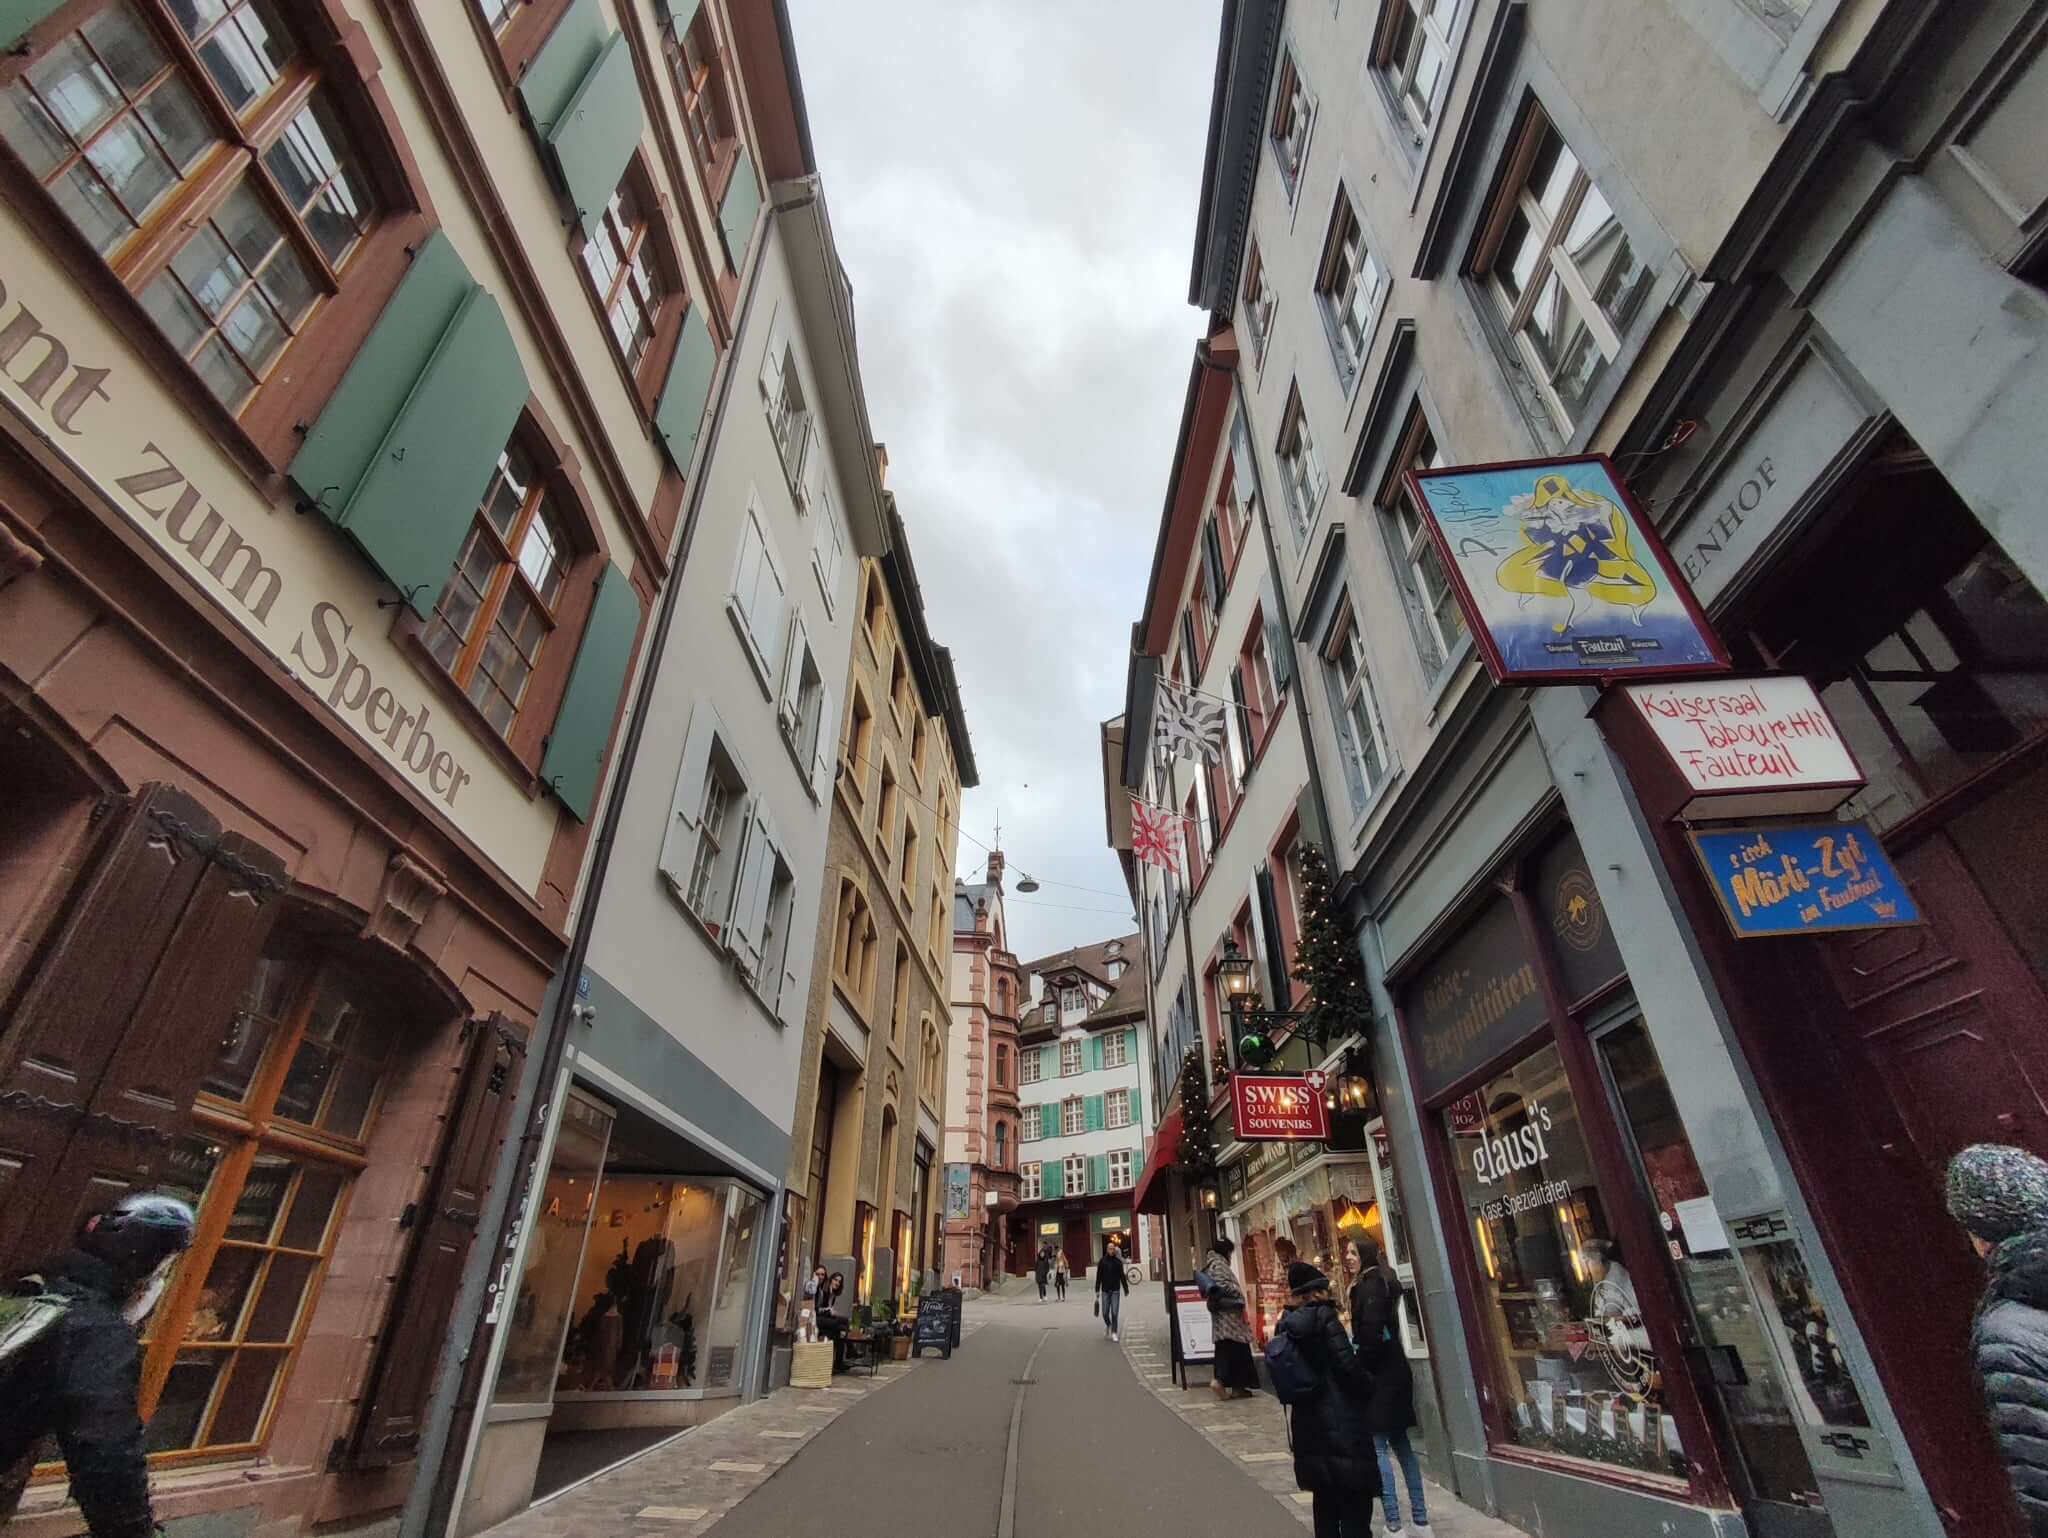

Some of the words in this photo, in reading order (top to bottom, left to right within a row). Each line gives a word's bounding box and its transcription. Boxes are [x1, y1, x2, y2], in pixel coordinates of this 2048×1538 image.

[0, 279, 111, 435] nt
[291, 602, 471, 808] Sperber
[1640, 684, 1767, 719] Kaisersaal
[1685, 708, 1832, 749] Tabourettli
[1680, 743, 1804, 782] Fauteuil
[1245, 1085, 1311, 1104] SWISS
[1247, 1104, 1310, 1116] QUALITY
[1248, 1119, 1313, 1129] SOUVENIRS
[1473, 1099, 1552, 1186] glausi's
[1503, 1179, 1572, 1219] Spezialitäten
